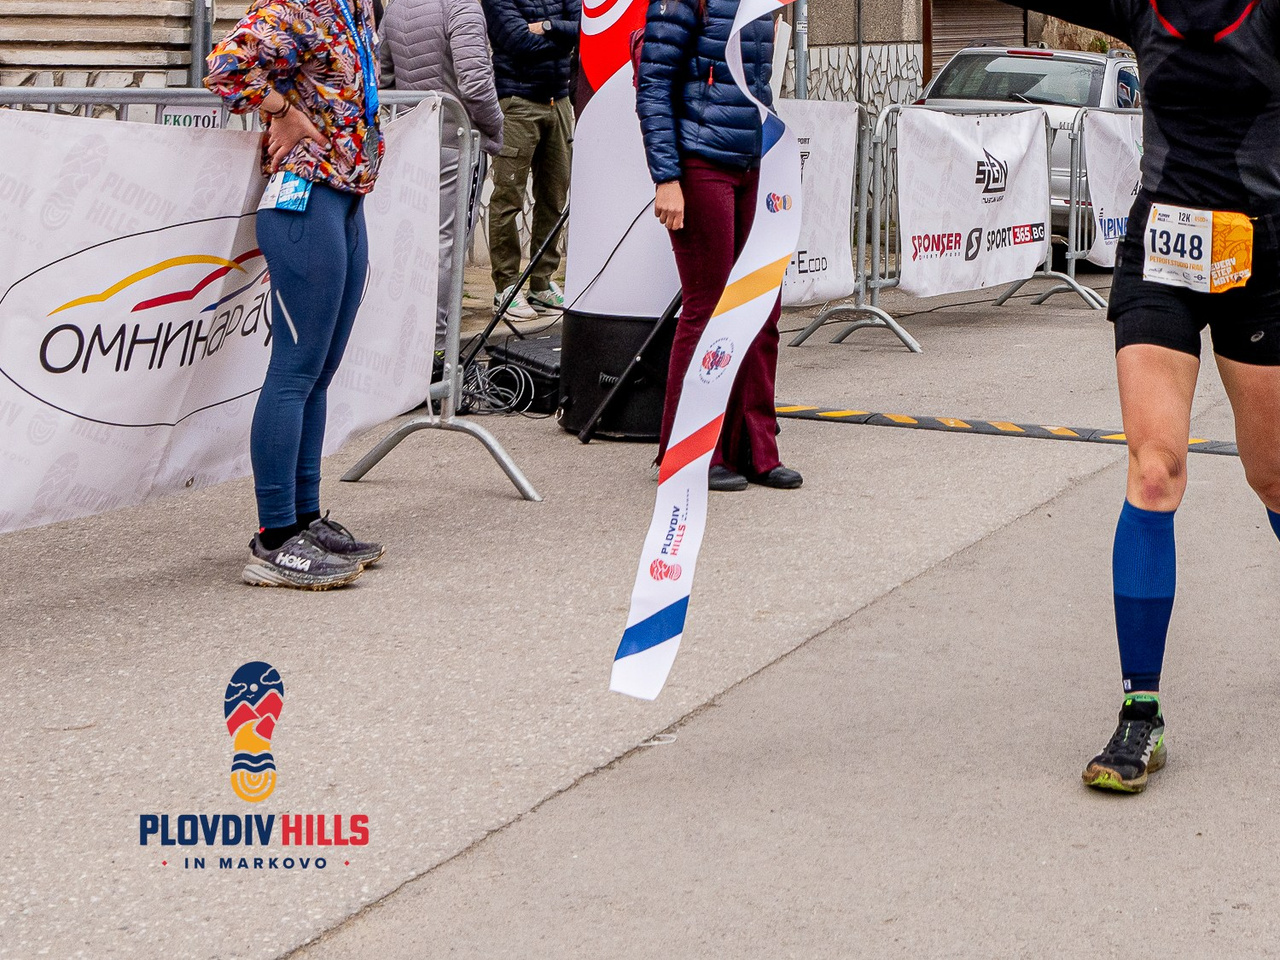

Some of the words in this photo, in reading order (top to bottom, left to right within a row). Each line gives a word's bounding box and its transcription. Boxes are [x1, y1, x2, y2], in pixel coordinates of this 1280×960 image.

[1178, 212, 1191, 222] 12K
[911, 232, 962, 261] SPONSER
[1149, 228, 1203, 260] 1348
[661, 505, 680, 555] PLOVDIV
[670, 524, 686, 556] HILLS
[275, 552, 311, 571] HOKA
